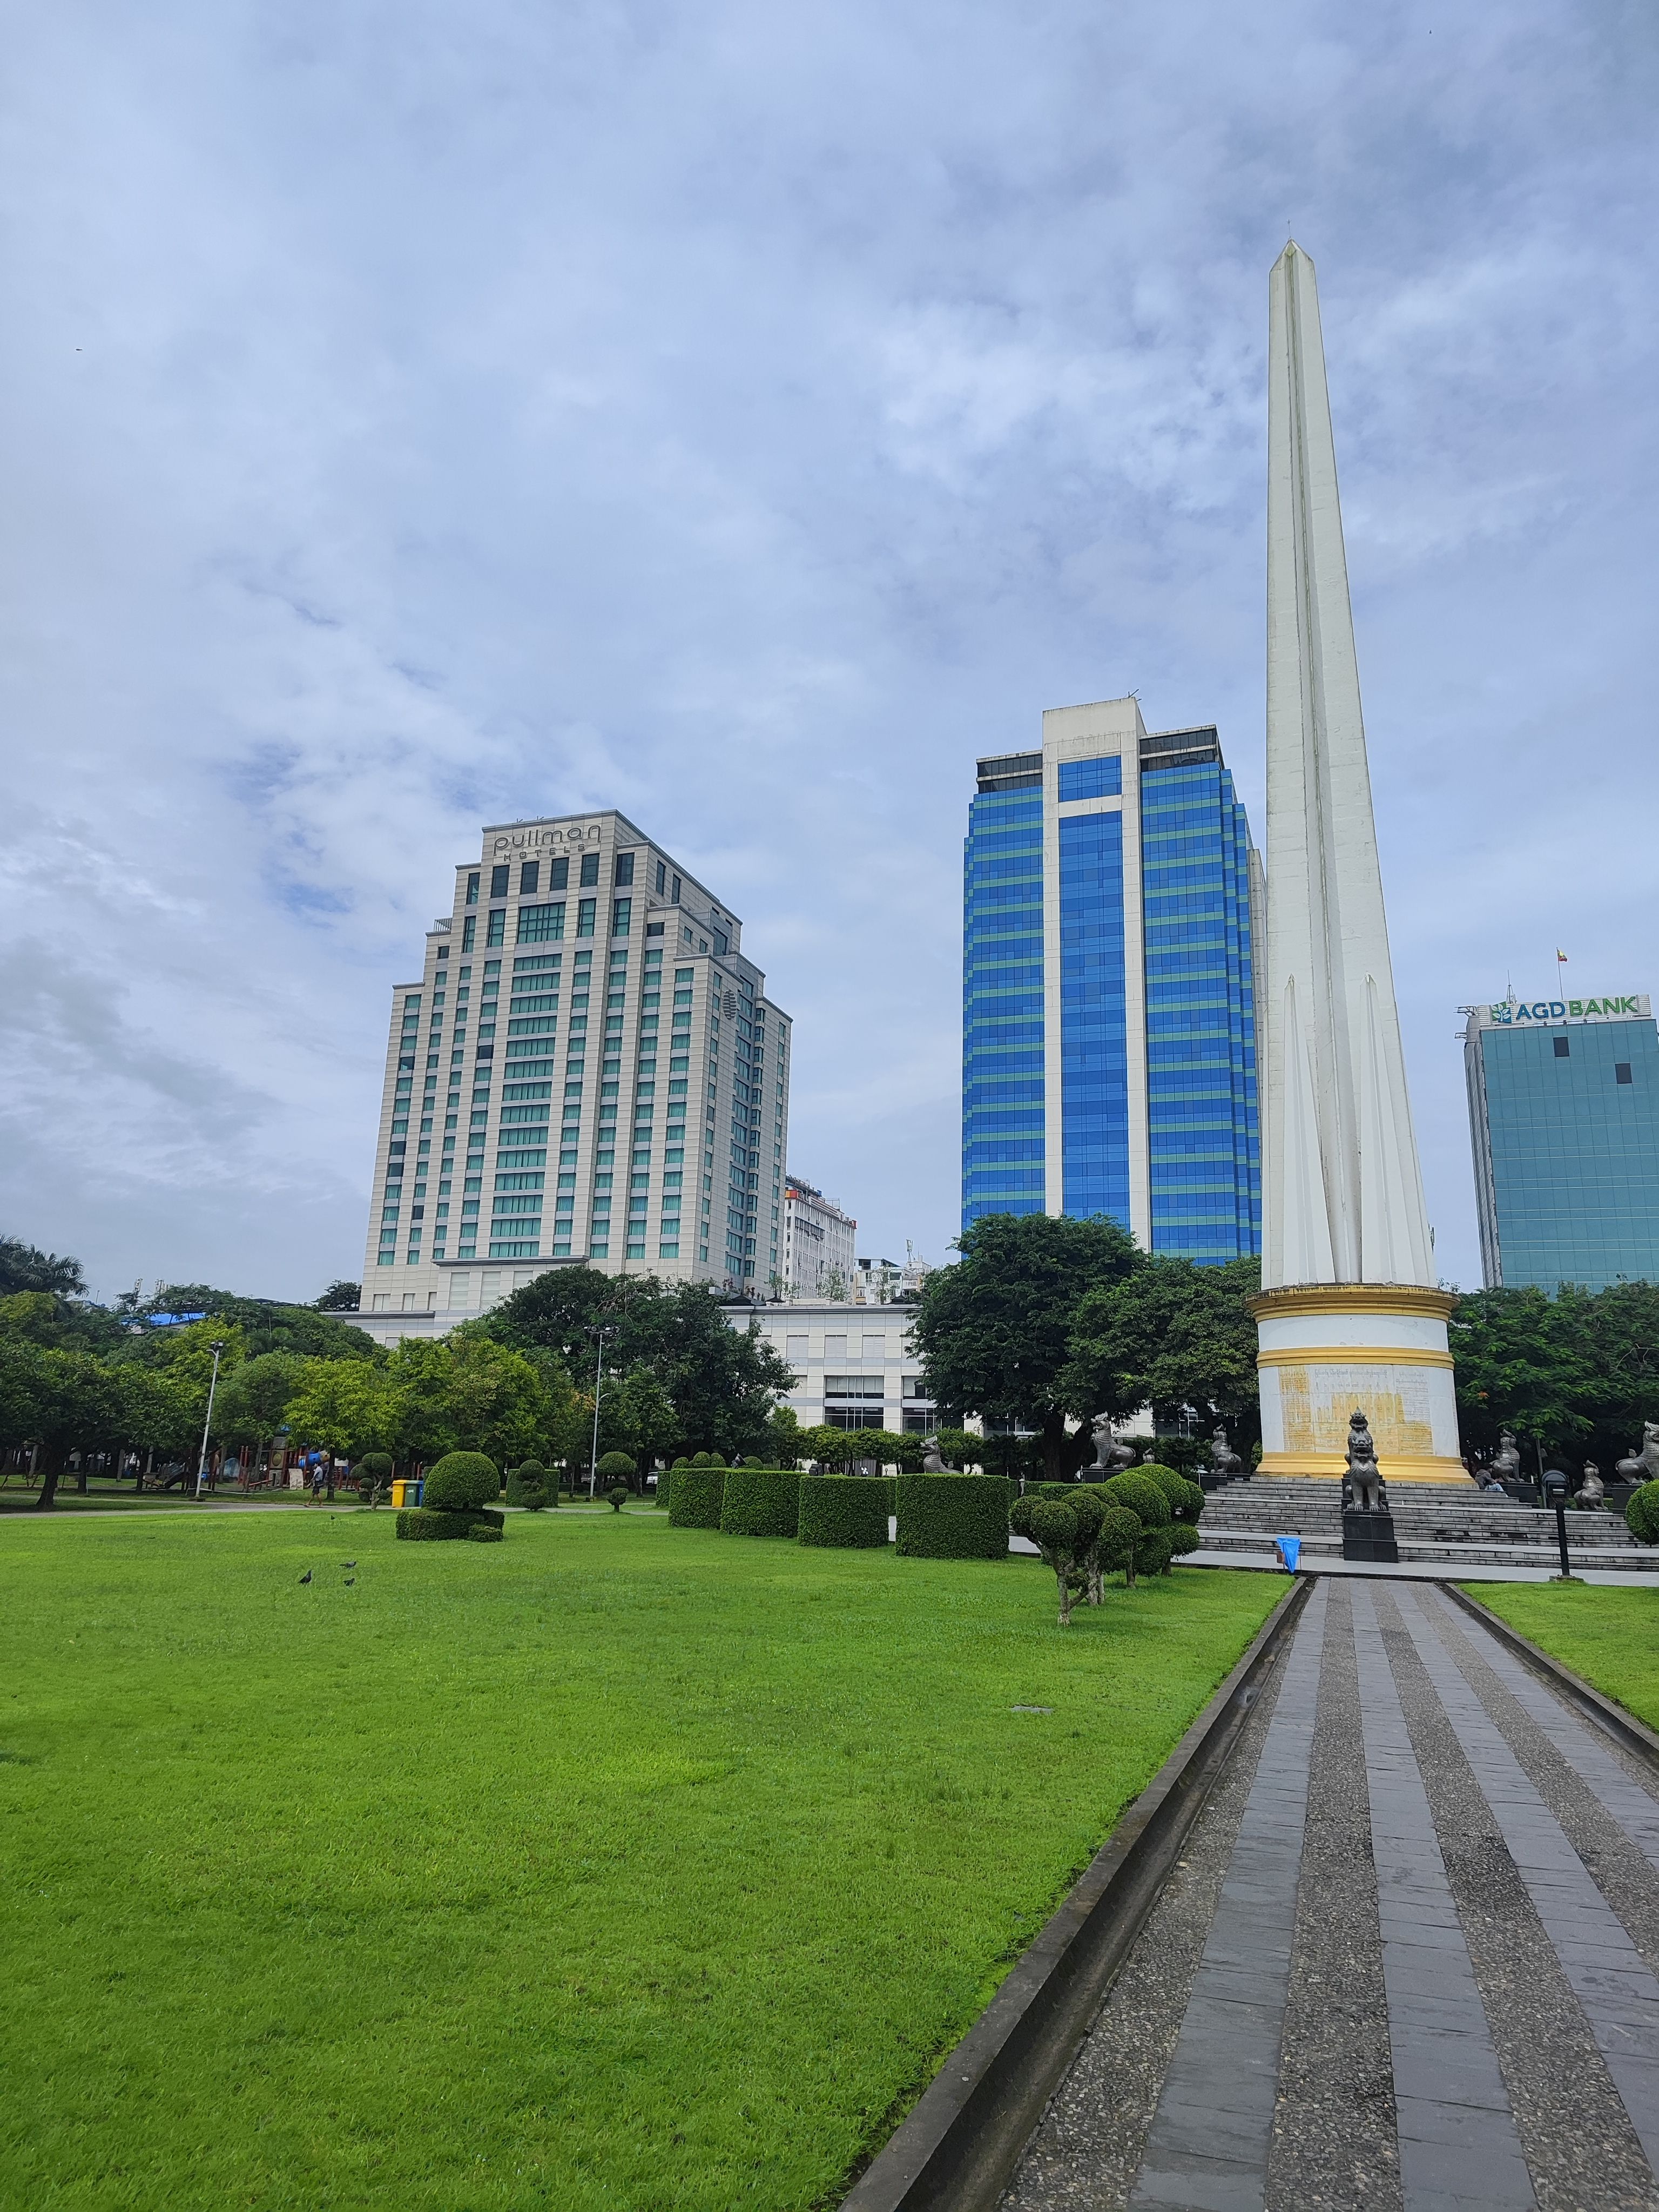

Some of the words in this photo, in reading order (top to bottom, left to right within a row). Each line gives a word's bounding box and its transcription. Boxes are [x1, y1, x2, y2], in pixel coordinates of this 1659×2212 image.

[494, 825, 601, 856] pullman
[504, 844, 585, 861] HOTELS
[1516, 1002, 1566, 1020] AGD
[1569, 996, 1637, 1016] BANK
